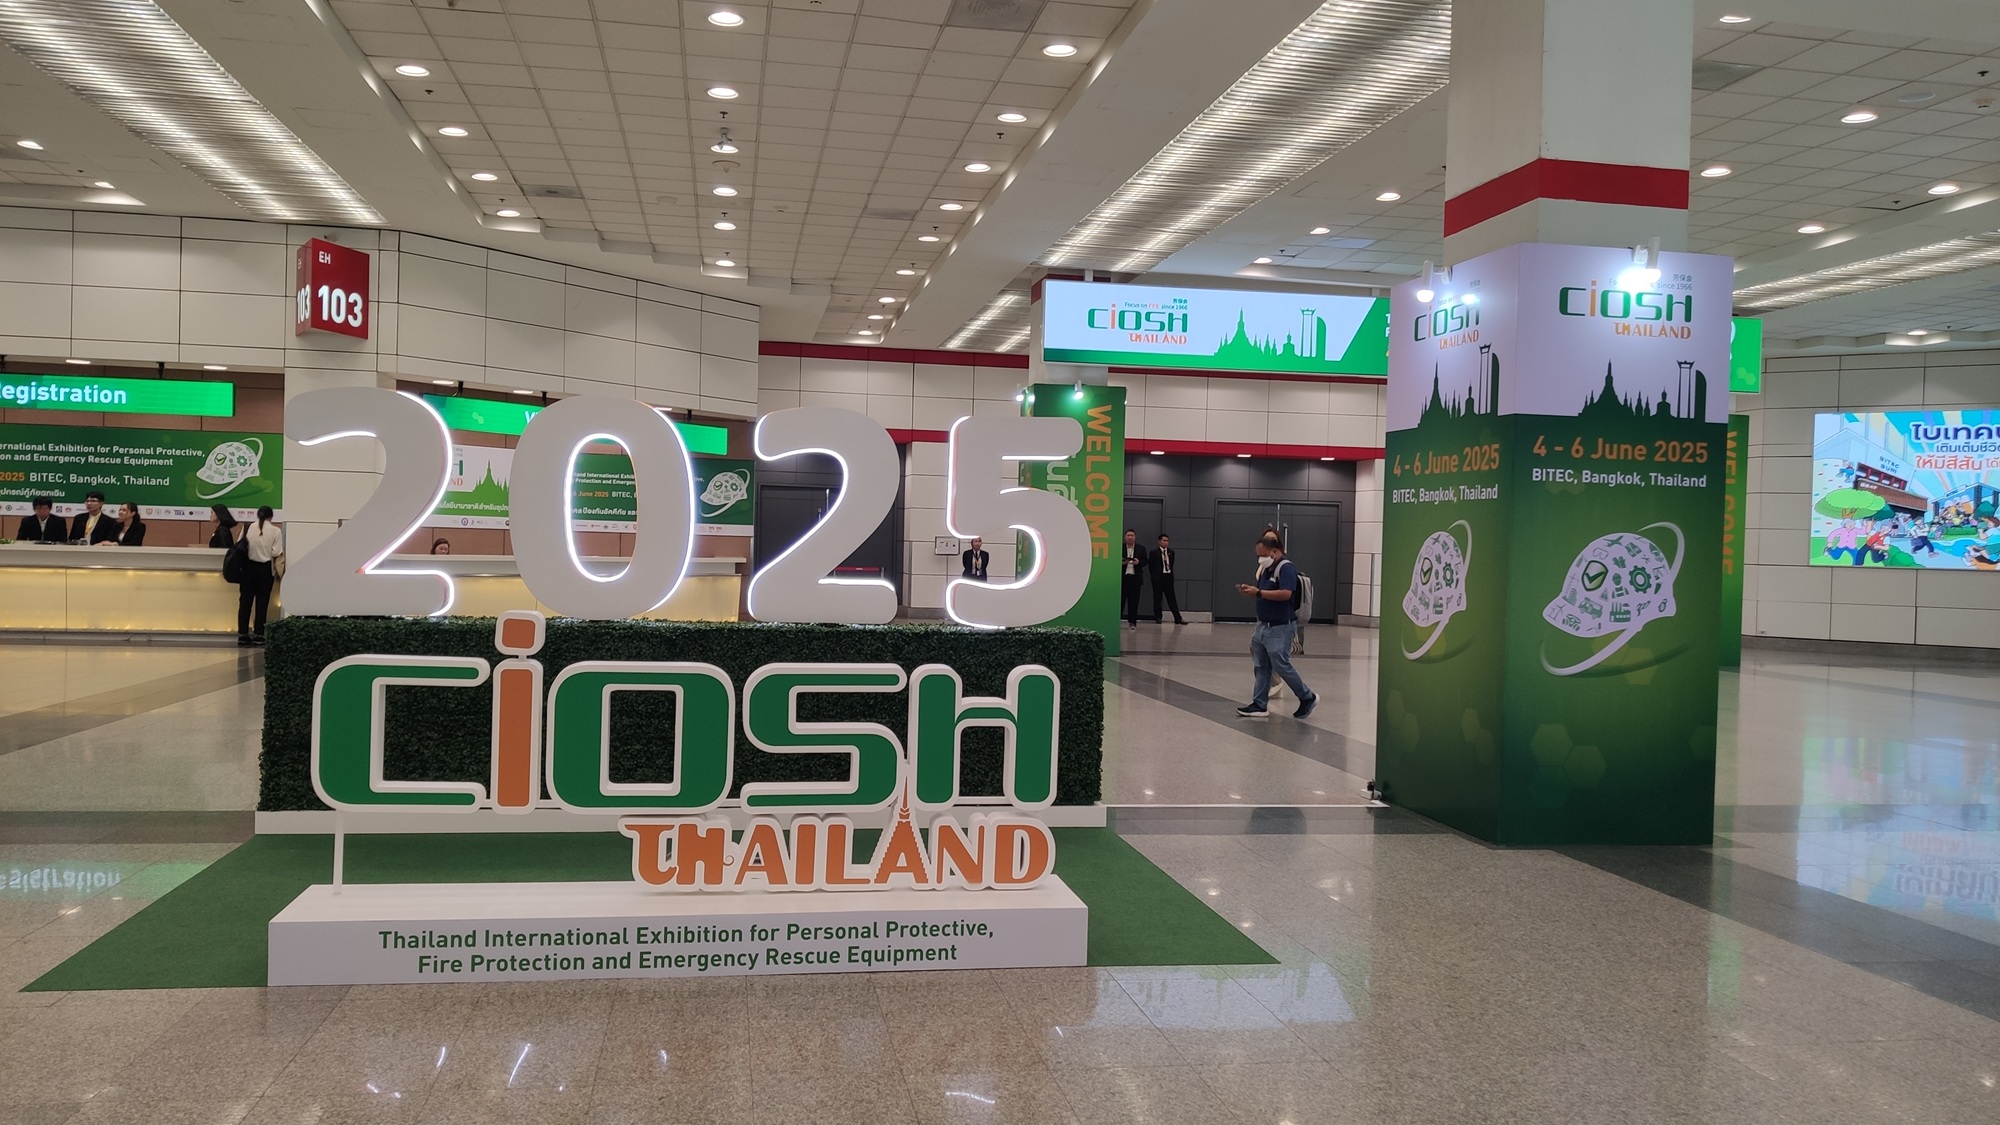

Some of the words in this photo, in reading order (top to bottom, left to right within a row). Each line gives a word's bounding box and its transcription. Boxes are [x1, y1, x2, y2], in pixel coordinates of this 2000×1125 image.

[319, 250, 331, 265] EH
[297, 284, 310, 324] 103
[318, 284, 363, 328] 103
[0, 381, 127, 405] egistration
[13, 453, 31, 461] and
[33, 453, 86, 465] Emergency
[88, 457, 121, 465] Rescue
[123, 457, 173, 467] Equipment
[48, 443, 96, 453] Exhibition
[97, 445, 111, 453] for
[113, 446, 154, 455] Personal
[156, 448, 206, 458] Protective,
[1393, 454, 1402, 477] 4
[1413, 452, 1422, 476] 6
[1424, 451, 1459, 475] June
[1462, 443, 1500, 472] 2025
[1532, 435, 1547, 457] 4
[1571, 436, 1585, 459] 6
[1590, 438, 1648, 461] June
[1654, 440, 1709, 464] 2025
[0, 471, 25, 482] 2025
[29, 472, 66, 484] BITEC,
[69, 473, 120, 487] Bangkok,
[123, 475, 170, 486] Thailand
[1085, 404, 1112, 560] WELCOME
[1532, 468, 1578, 485] BITEC,
[1582, 470, 1645, 487] Bangkok,
[1649, 472, 1707, 487] Thailand
[1392, 488, 1418, 504] BITEC,
[1419, 486, 1457, 505] Bangkok,
[1459, 484, 1498, 501] Thailand
[282, 390, 1091, 630] 2025
[617, 800, 1058, 893] THAILAND
[378, 929, 478, 949] Thailand
[484, 926, 629, 948] International
[635, 925, 744, 945] Exhibition
[749, 924, 780, 942] for
[786, 921, 880, 941] Personal
[885, 919, 994, 940] Protective,
[418, 954, 463, 973] Fire
[470, 953, 585, 973] Protection
[592, 951, 632, 970] and
[638, 949, 760, 972] Emergency
[765, 947, 841, 966] Rescue
[847, 944, 958, 967] Equipment
